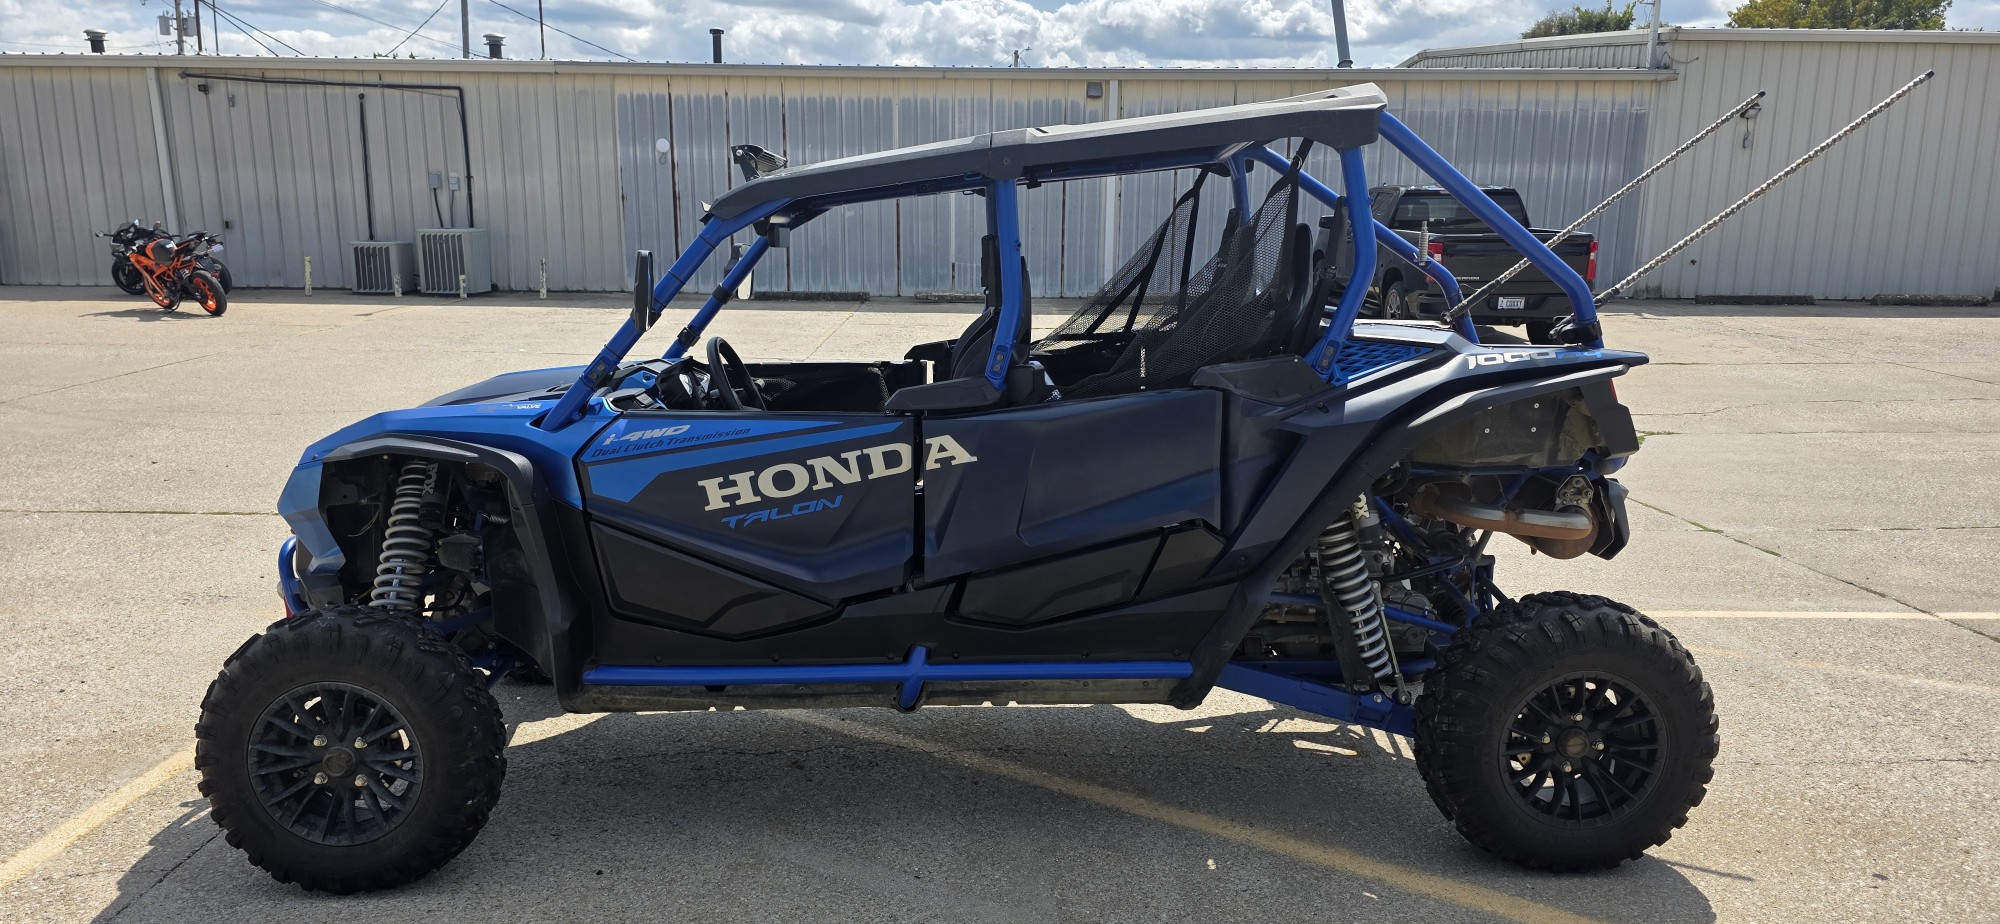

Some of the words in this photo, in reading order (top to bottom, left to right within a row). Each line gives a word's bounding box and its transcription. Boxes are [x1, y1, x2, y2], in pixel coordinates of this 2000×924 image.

[591, 447, 624, 458] Dual
[623, 437, 665, 453] Clutch
[667, 427, 751, 446] Transmission
[602, 424, 691, 446] i-4WD
[421, 462, 439, 497] FOX
[697, 434, 978, 512] HONDA
[720, 495, 843, 530] TALON
[1353, 491, 1370, 520] OX
